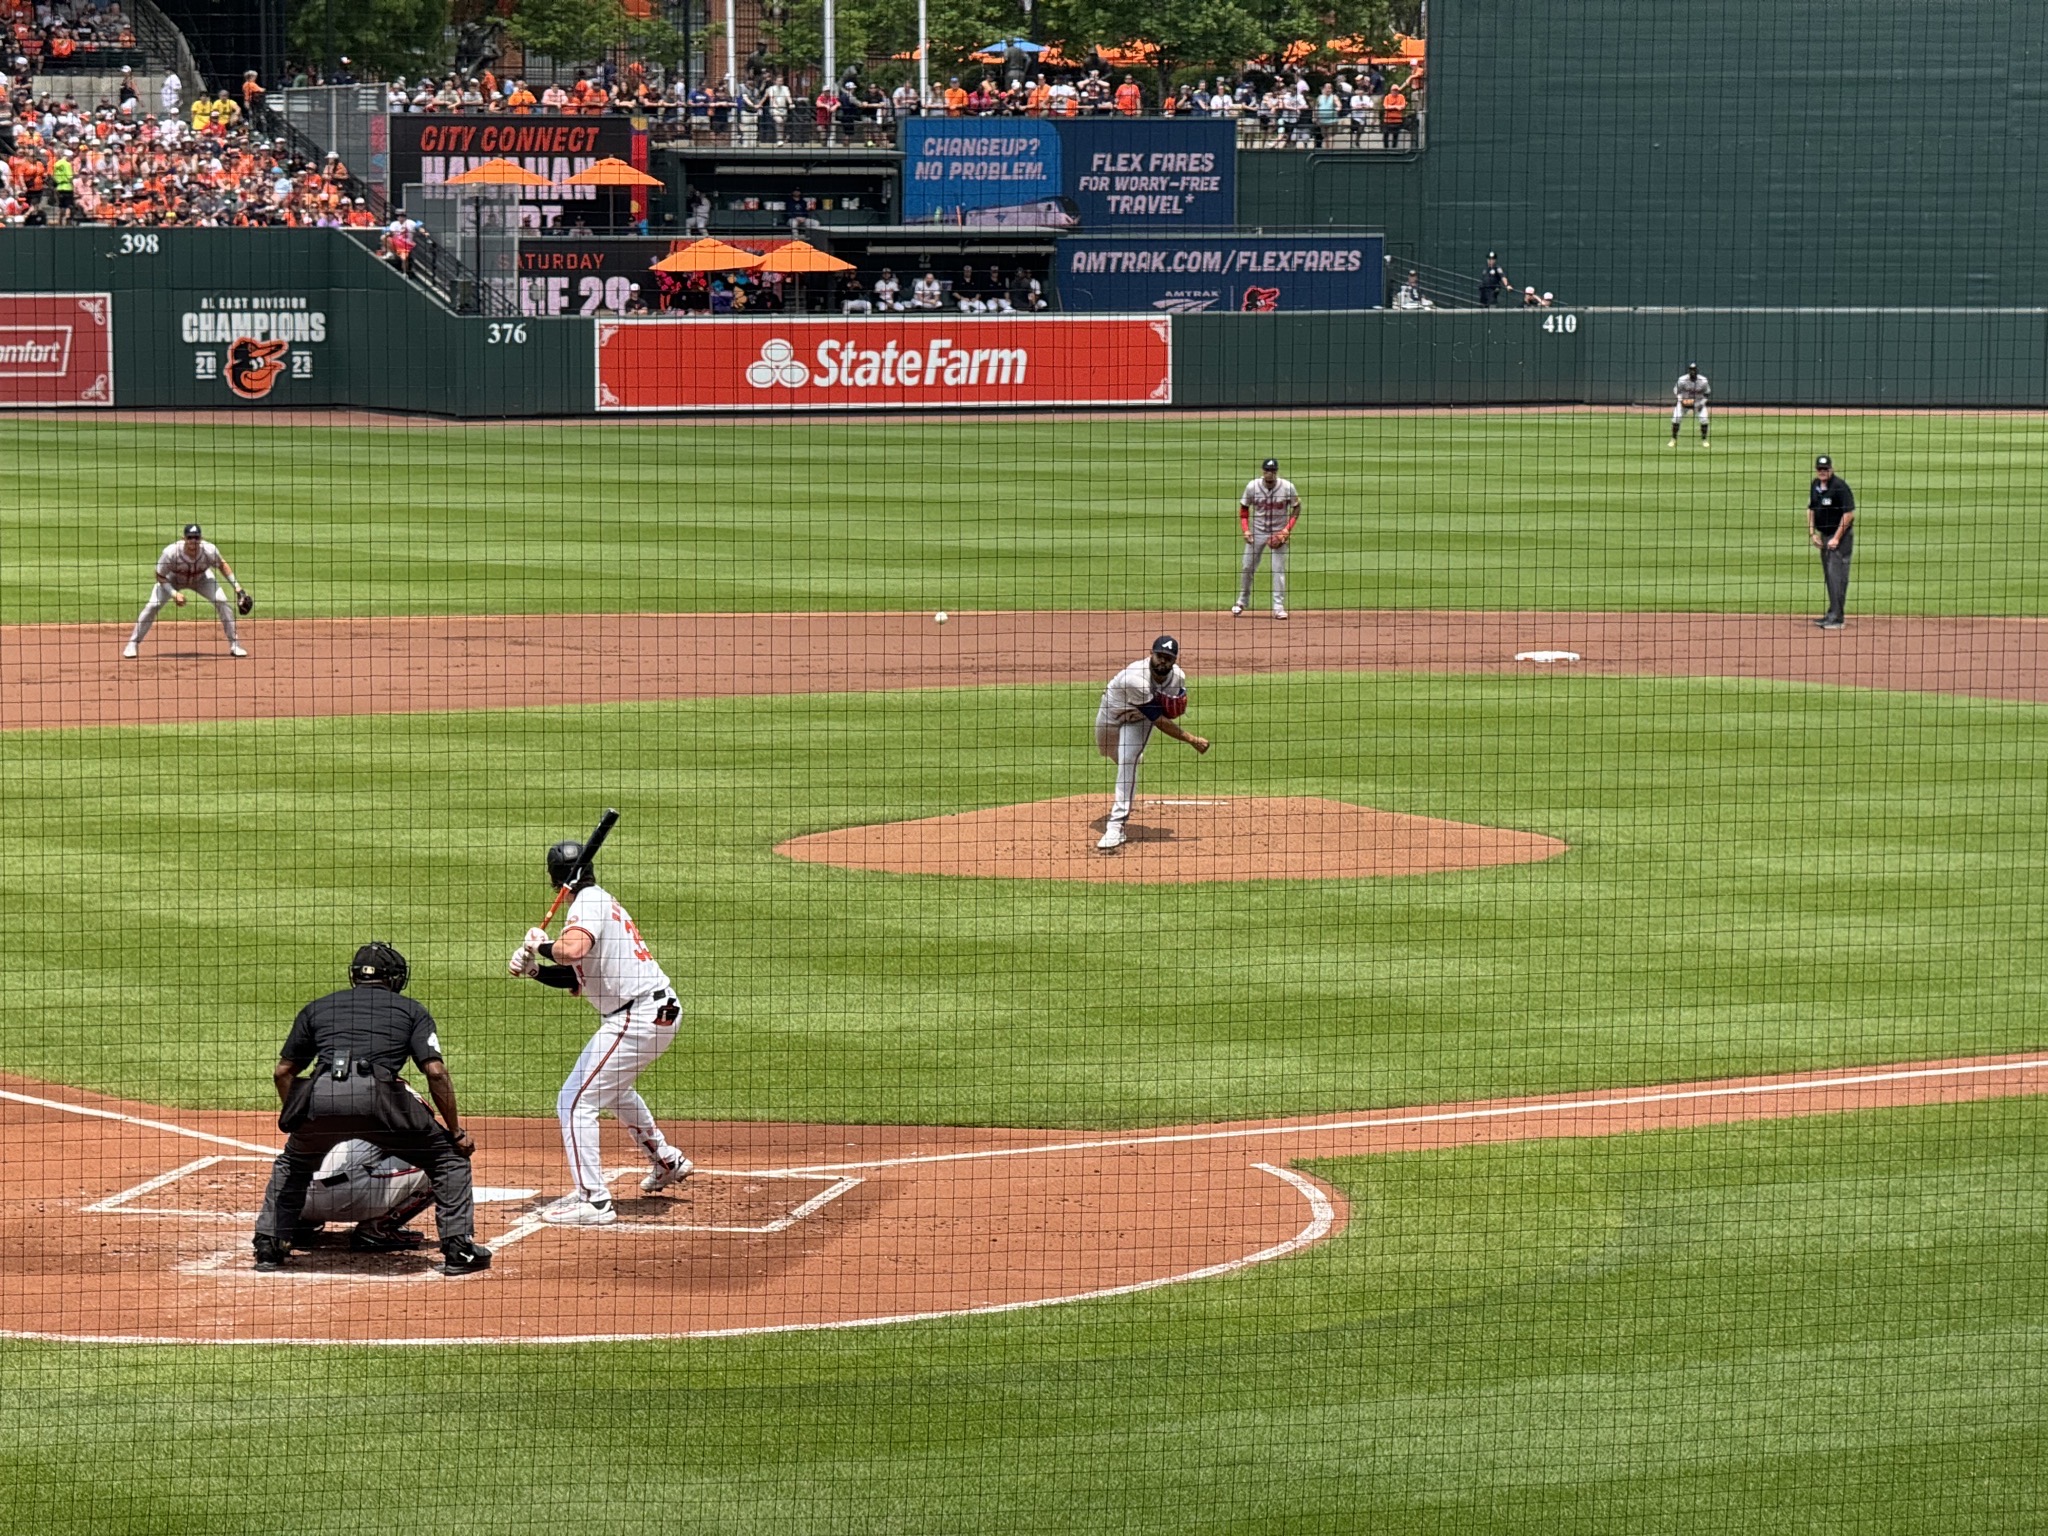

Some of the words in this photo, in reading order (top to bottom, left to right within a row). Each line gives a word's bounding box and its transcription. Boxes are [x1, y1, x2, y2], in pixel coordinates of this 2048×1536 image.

[420, 125, 477, 153] CITY
[480, 125, 600, 153] CONNECT
[922, 137, 1041, 156] CHANGEUP?
[914, 161, 943, 181] NO
[949, 161, 1048, 181] PROBLEM.
[1091, 153, 1144, 172] FLEX
[1148, 152, 1216, 172] FARES
[1078, 176, 1110, 191] FOR
[1114, 176, 1220, 192] WORRY-FREE
[119, 233, 160, 255] 398
[1071, 249, 1363, 275] AMTRAK.COM/FLEXFARES
[201, 297, 216, 310] AL
[219, 297, 249, 310] EAST
[252, 297, 307, 310] DIVISION
[1164, 290, 1220, 298] AMTRAK
[182, 312, 327, 343] CHAMPIONS
[1542, 314, 1577, 333] 410
[487, 323, 527, 344] 376
[195, 356, 217, 374] 20
[292, 356, 313, 373] 23
